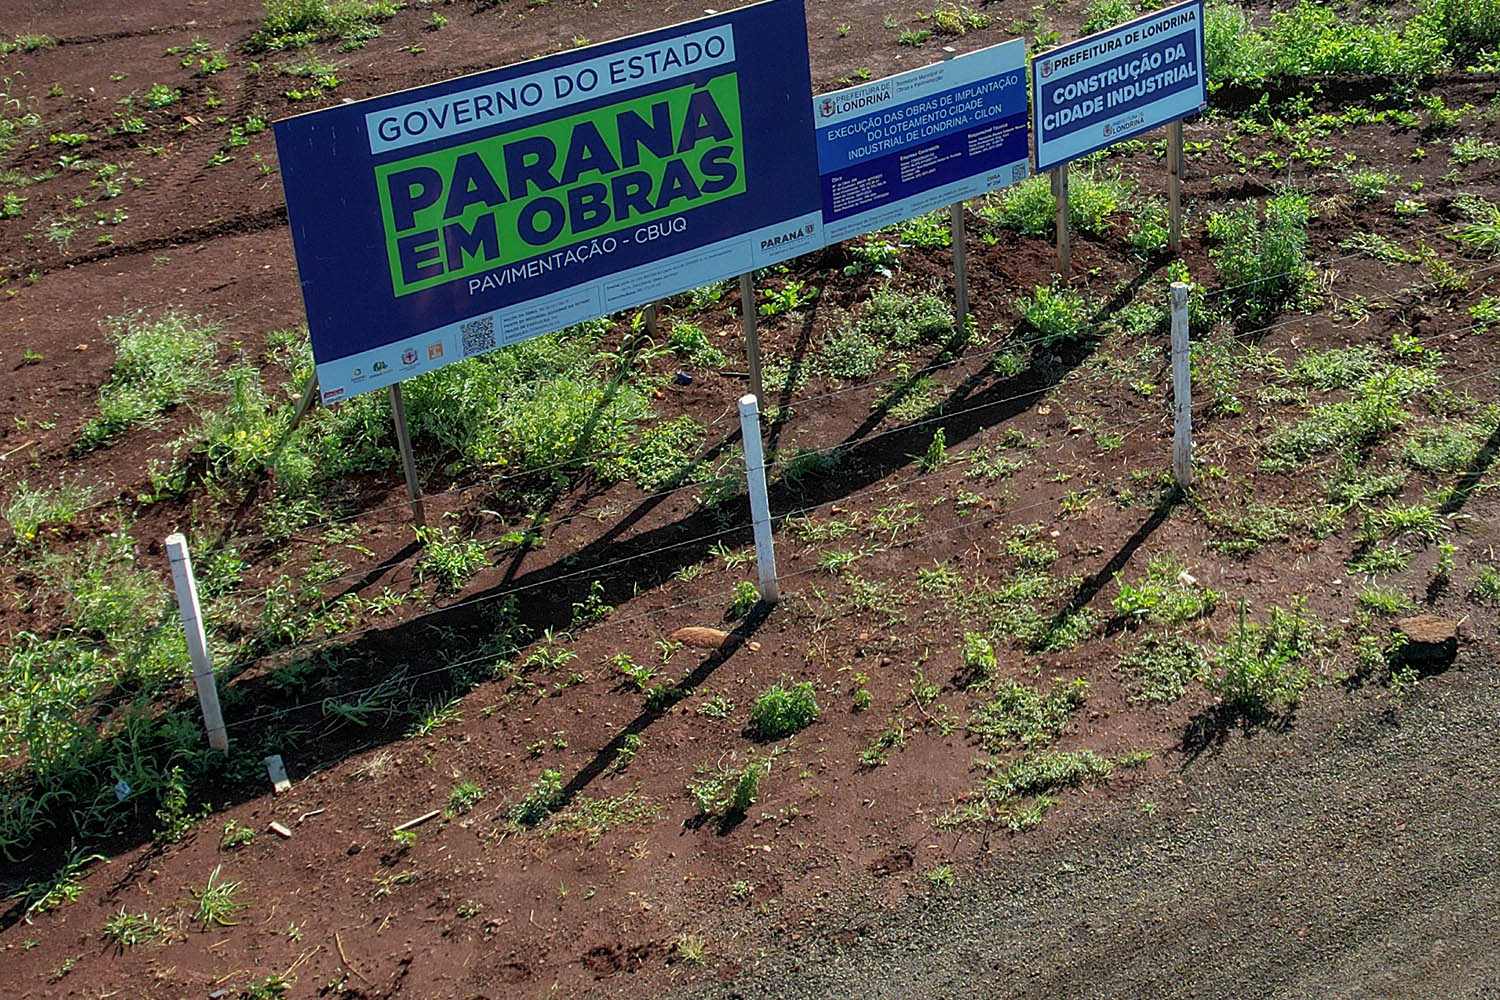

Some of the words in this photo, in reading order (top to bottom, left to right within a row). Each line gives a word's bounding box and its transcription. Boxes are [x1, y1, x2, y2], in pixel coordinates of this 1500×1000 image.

[1054, 38, 1122, 71] PREFEITURA
[1125, 31, 1139, 45] DE
[1142, 11, 1195, 40] LONDRINA
[378, 83, 543, 143] GOVERNO
[554, 68, 598, 99] DO
[609, 34, 726, 85] ESTADO
[835, 85, 880, 103] PREFEITURA
[881, 82, 891, 91] DE
[836, 91, 891, 114] LONDRINA
[1043, 96, 1104, 131] CIDADE
[1106, 62, 1197, 108] INDUSTRIAL
[1053, 52, 1162, 105] CONSTRUÇÃO
[1164, 43, 1186, 64] DA
[827, 117, 882, 140] EXECUÇÃO
[884, 110, 904, 124] DAS
[905, 100, 938, 116] OBRAS
[940, 95, 952, 107] DE
[955, 75, 1018, 102] IMPLANTAÇÃO
[848, 135, 904, 160] INDUSTRIAL
[906, 131, 919, 142] DE
[921, 115, 968, 137] LONDRINA
[974, 104, 1002, 120] CILON
[867, 129, 882, 141] DO
[884, 109, 947, 137] LOTEAMENTO
[948, 97, 983, 115] CIDADE
[1112, 117, 1144, 135] LONDRINA
[388, 77, 733, 231] PARANÁ
[398, 213, 502, 284] EM
[517, 146, 738, 246] OBRAS
[760, 226, 805, 249] PARANÁ
[469, 236, 617, 295] PAVIMENTAÇÃO
[634, 217, 687, 243] CBUQ
